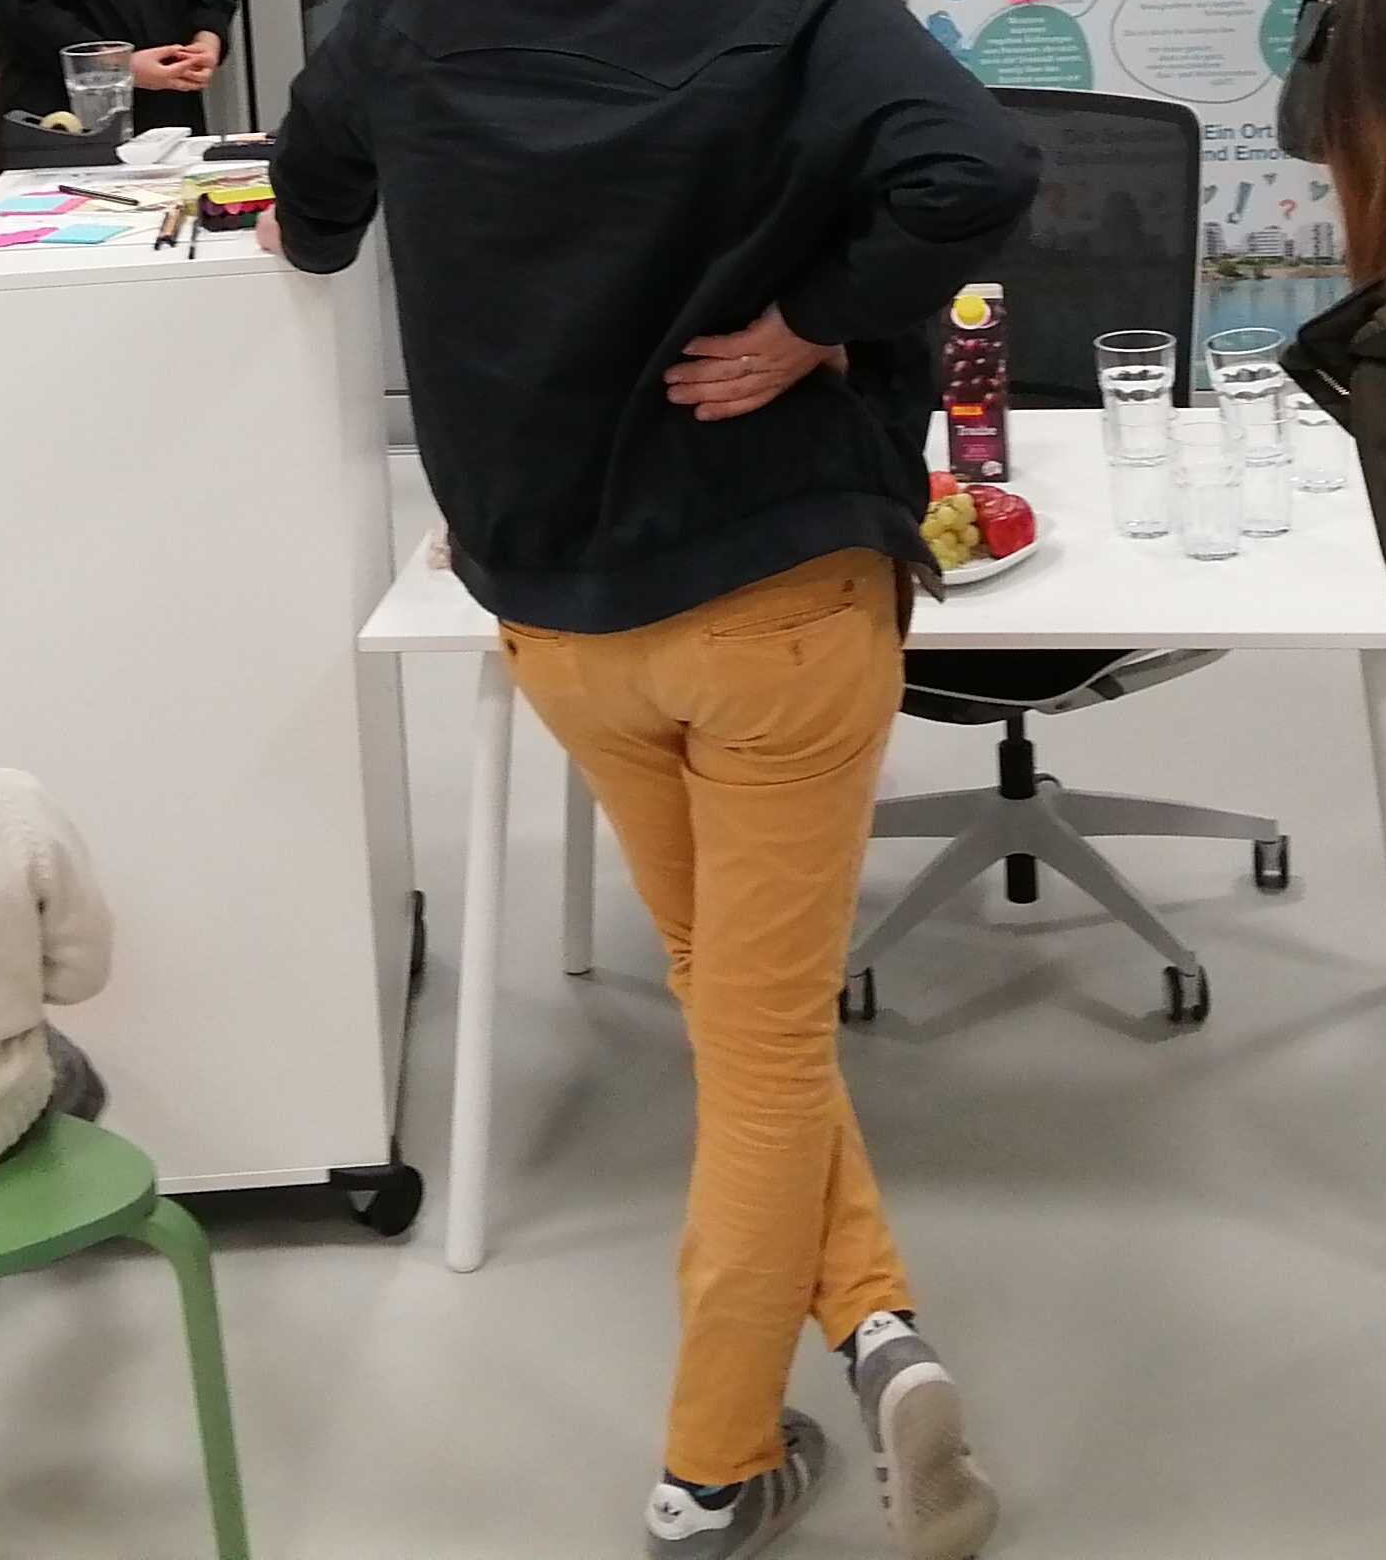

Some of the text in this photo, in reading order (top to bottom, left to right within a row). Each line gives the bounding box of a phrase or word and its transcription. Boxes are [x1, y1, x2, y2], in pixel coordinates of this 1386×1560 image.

[1204, 124, 1235, 139] Ein
[1241, 123, 1273, 139] Ort
[1203, 145, 1291, 161] nd Emo
